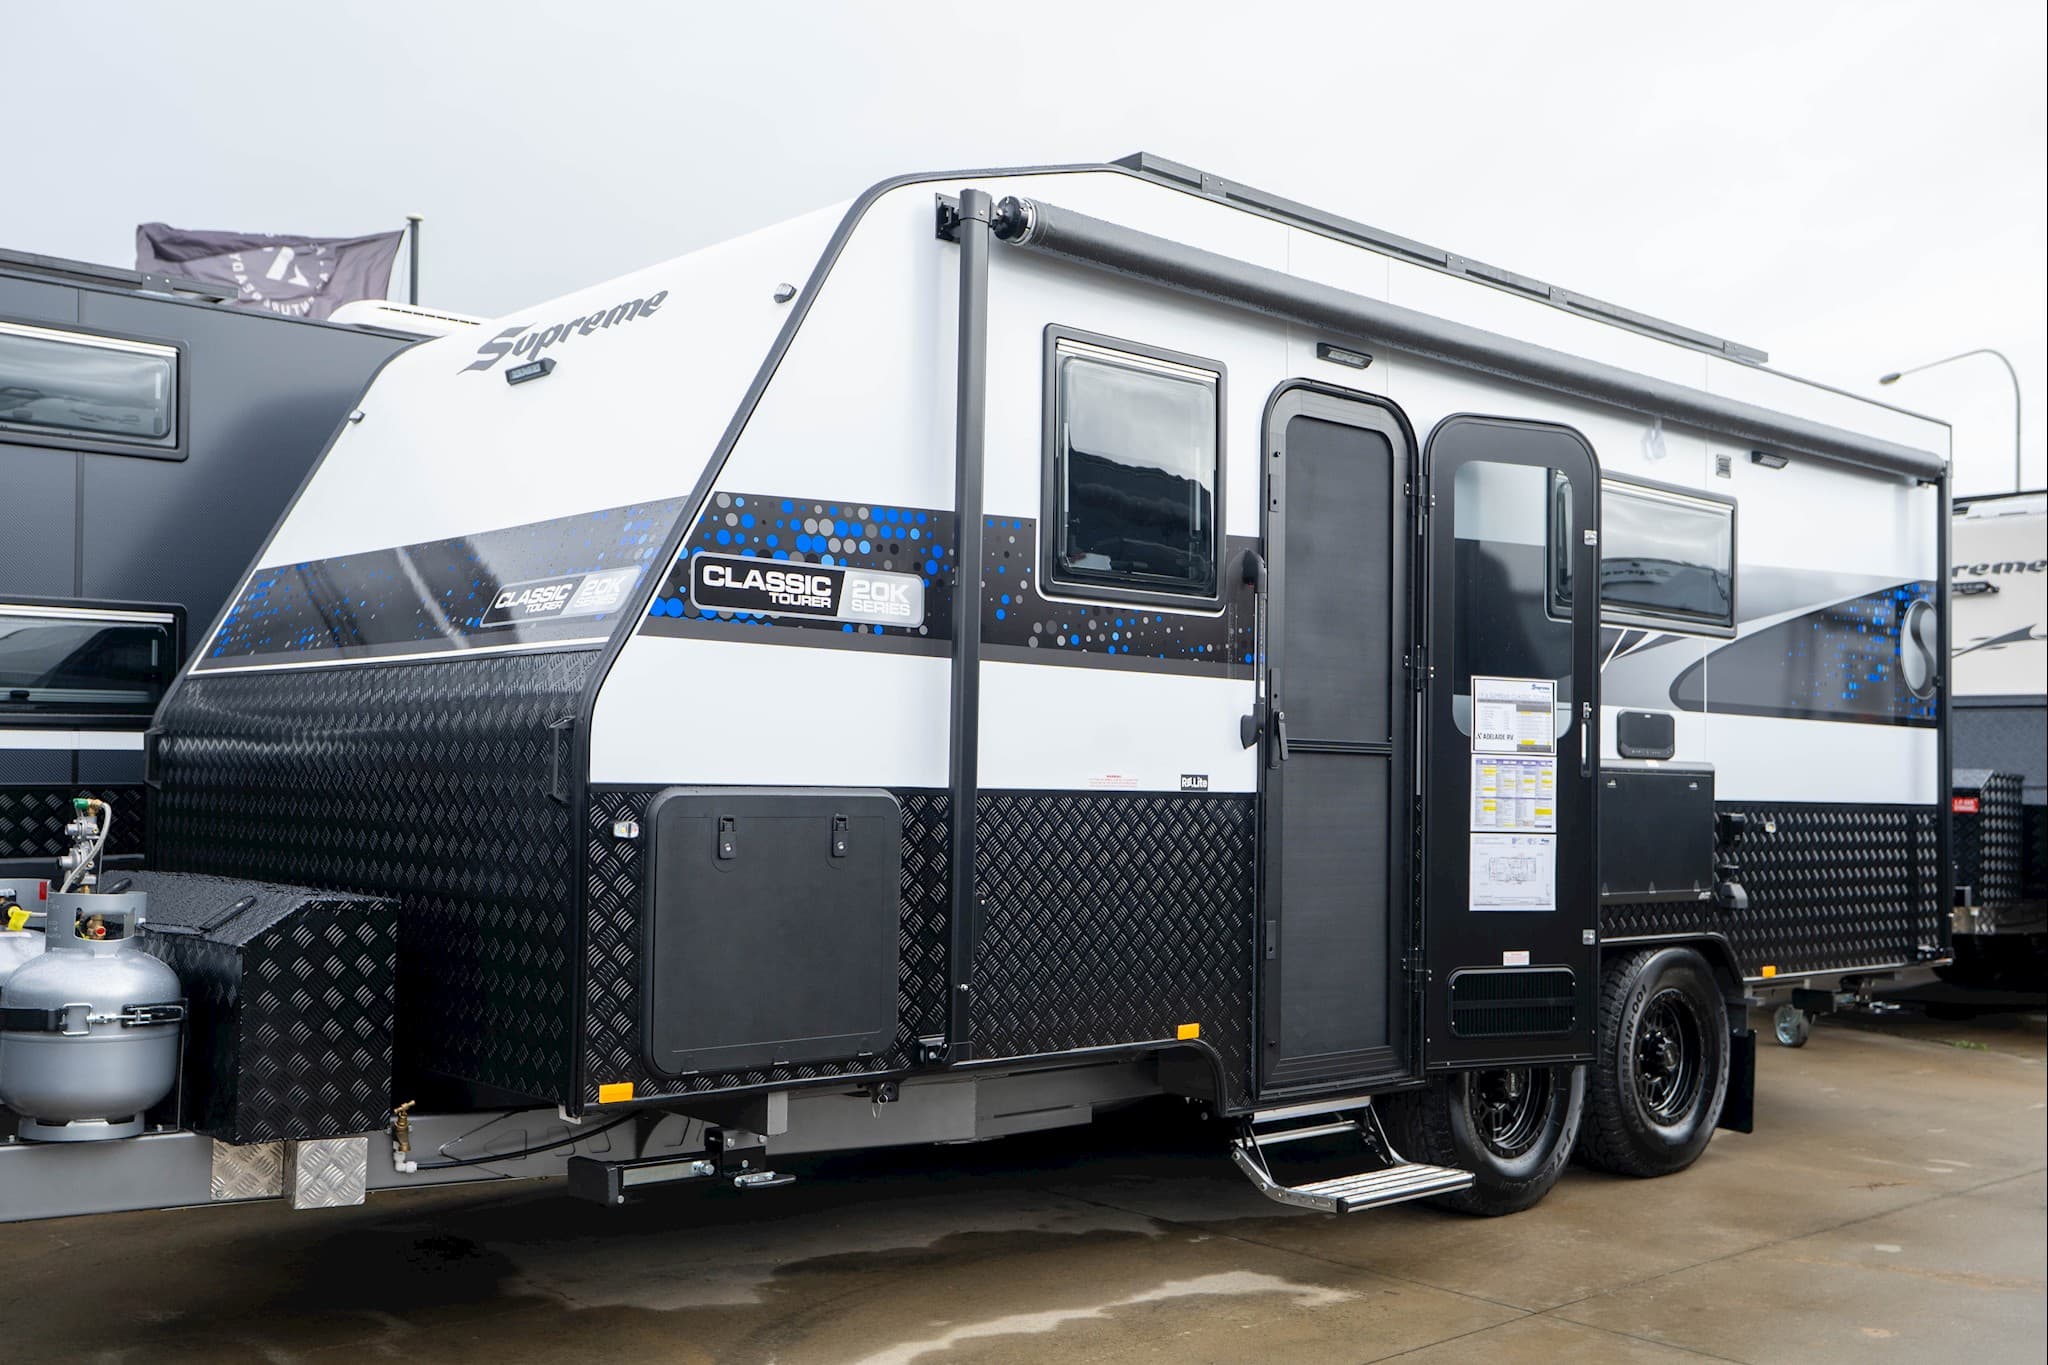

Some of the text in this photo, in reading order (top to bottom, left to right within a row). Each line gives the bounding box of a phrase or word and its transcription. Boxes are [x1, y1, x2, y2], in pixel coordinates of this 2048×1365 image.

[456, 289, 669, 376] Supreme
[1952, 560, 2047, 577] reme
[583, 575, 627, 594] 20K
[702, 564, 832, 598] CLASSIC
[494, 583, 573, 609] CLASSIC
[768, 591, 832, 609] TOURER
[851, 579, 911, 603] 20K
[525, 600, 566, 614] TOURER
[574, 594, 618, 608] SERIES
[851, 601, 911, 617] SERIES
